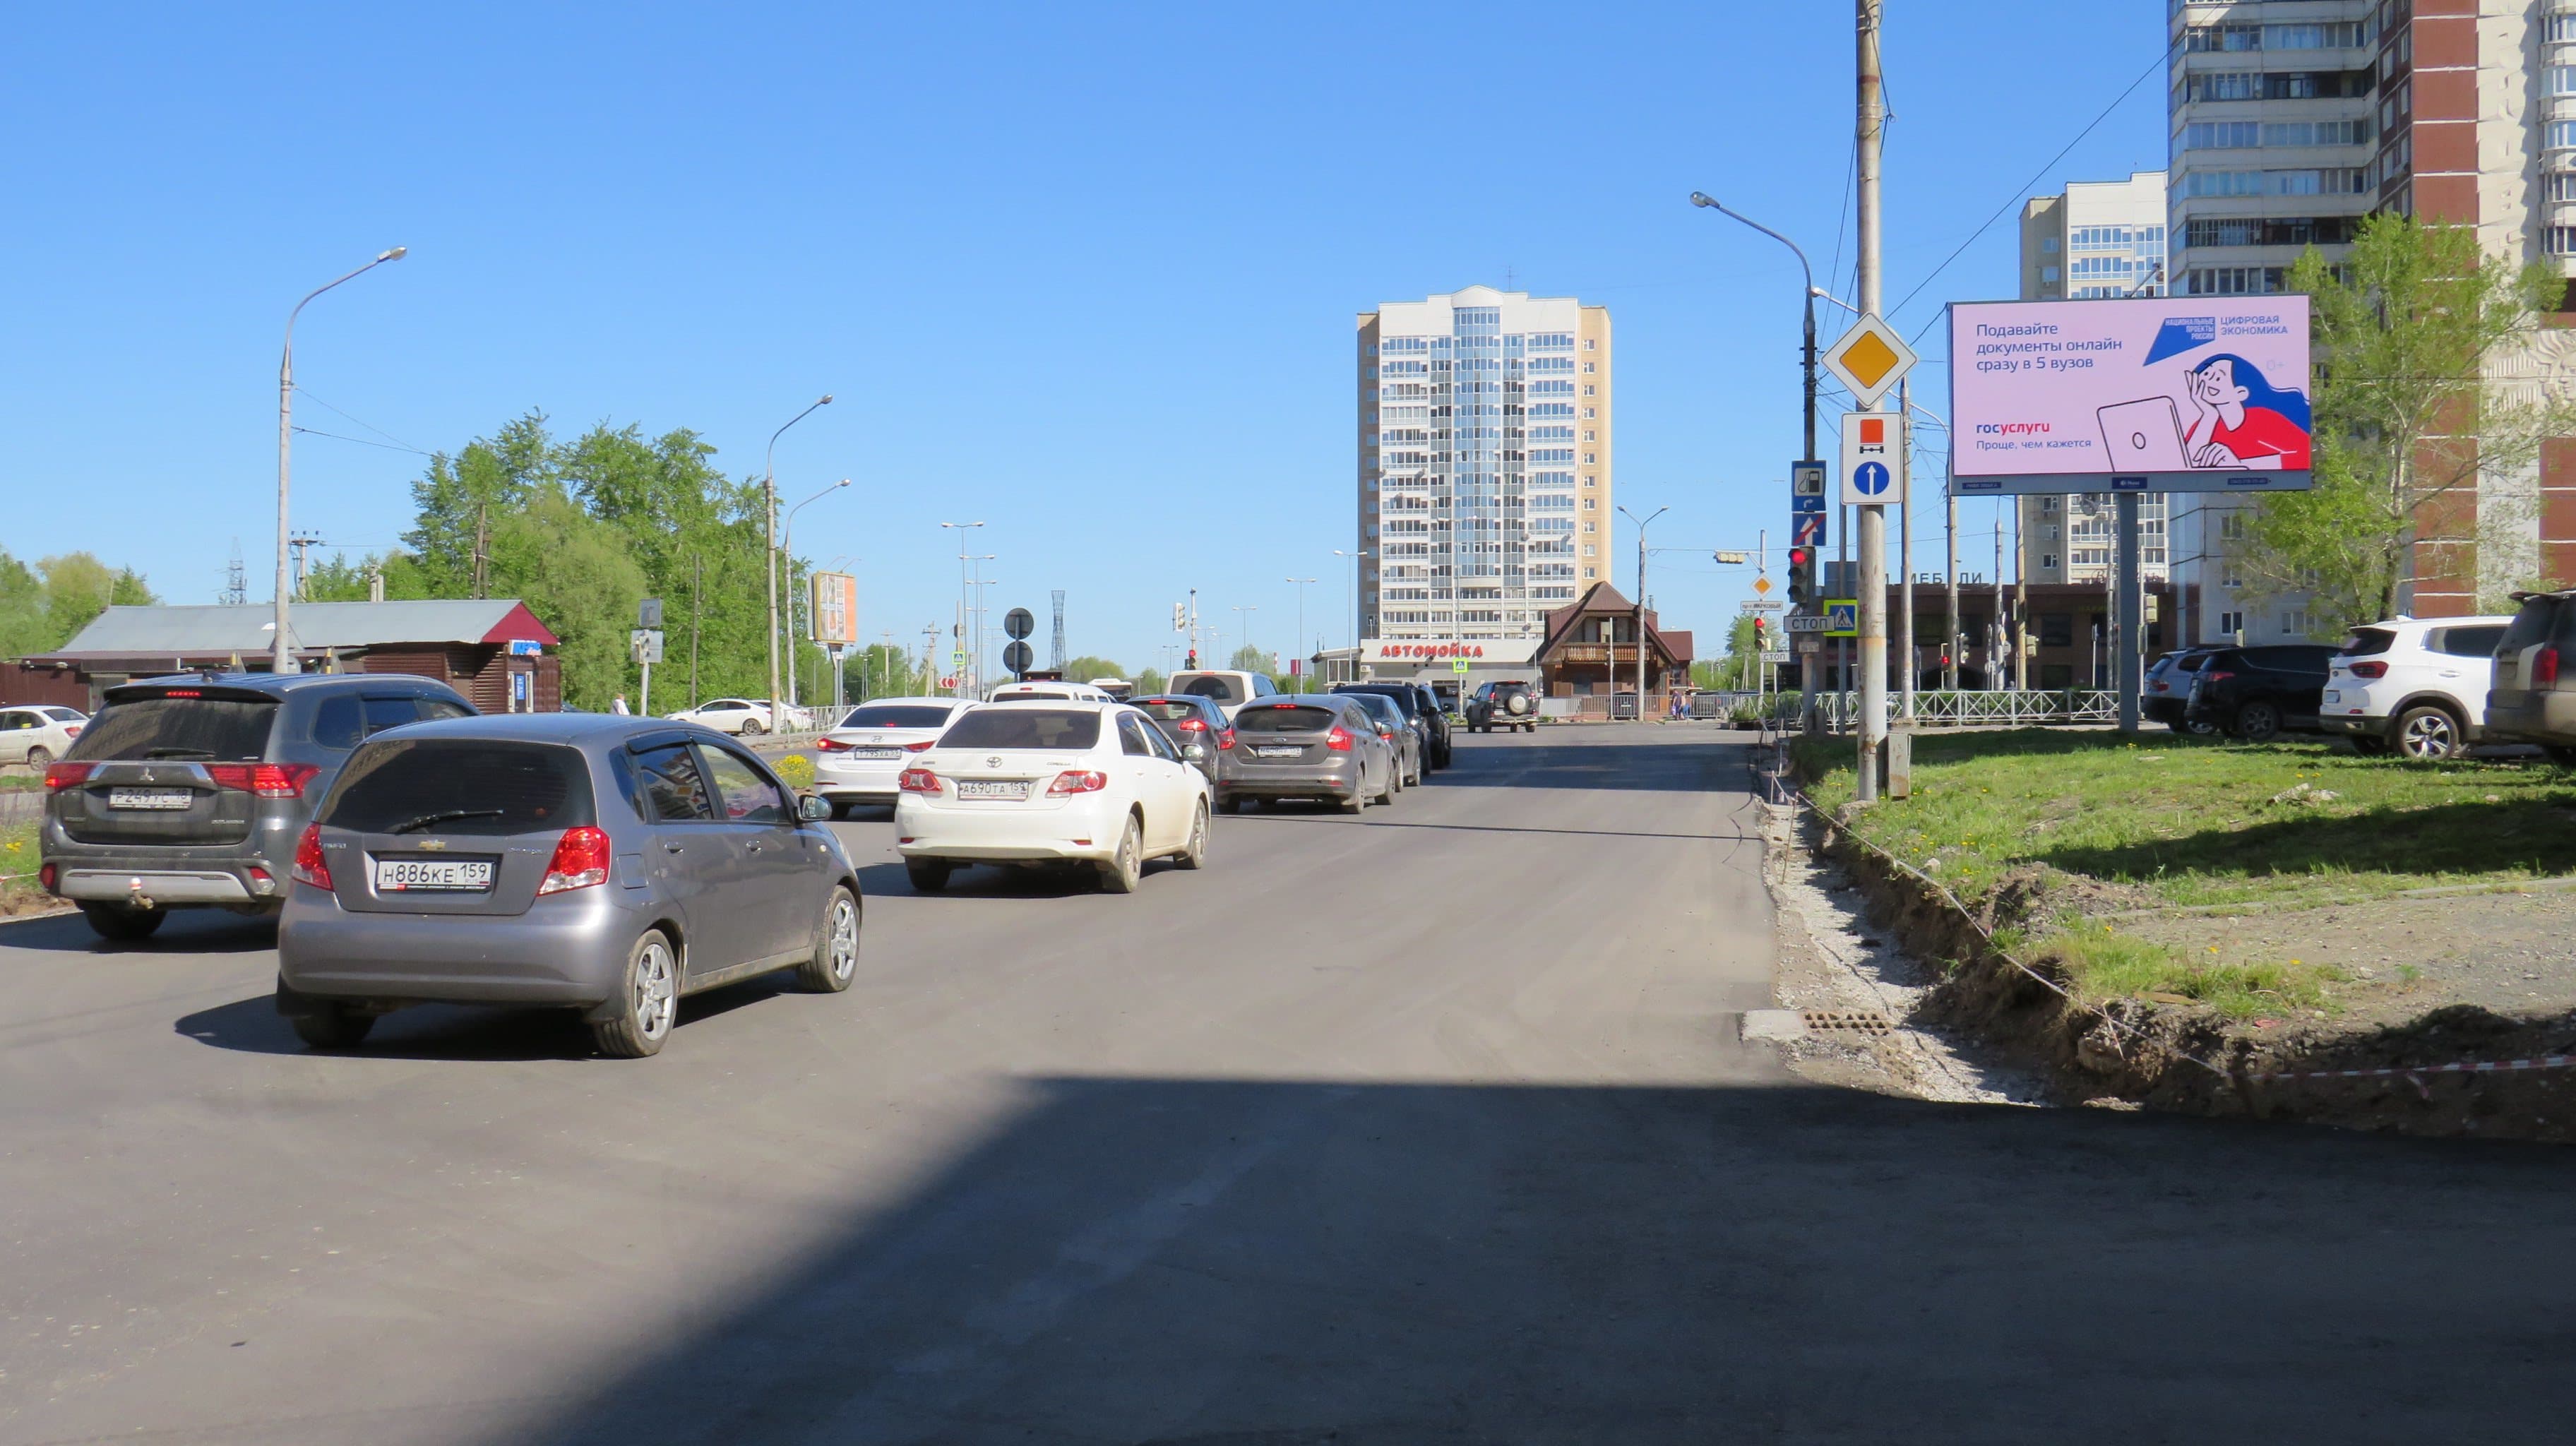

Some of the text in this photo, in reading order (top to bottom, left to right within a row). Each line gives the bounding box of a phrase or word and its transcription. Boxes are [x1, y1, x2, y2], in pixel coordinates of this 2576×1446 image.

[2220, 316, 2279, 325] ЦИФРОВАЯ
[1976, 323, 2058, 337] Подавайте
[2220, 325, 2288, 335] ЭКОНОМИКА
[1976, 337, 2122, 356] документы онлайн
[1976, 357, 2094, 373] сразу в 5 вузов
[1976, 423, 2050, 436] госуслуги
[1976, 440, 2091, 451] Проще, чем кажется
[1792, 619, 1827, 629] СТОП
[1381, 642, 1483, 657] АВТОМОЙКА
[963, 782, 1005, 794] А690ТА
[384, 864, 487, 883] Н886КЕ 159
